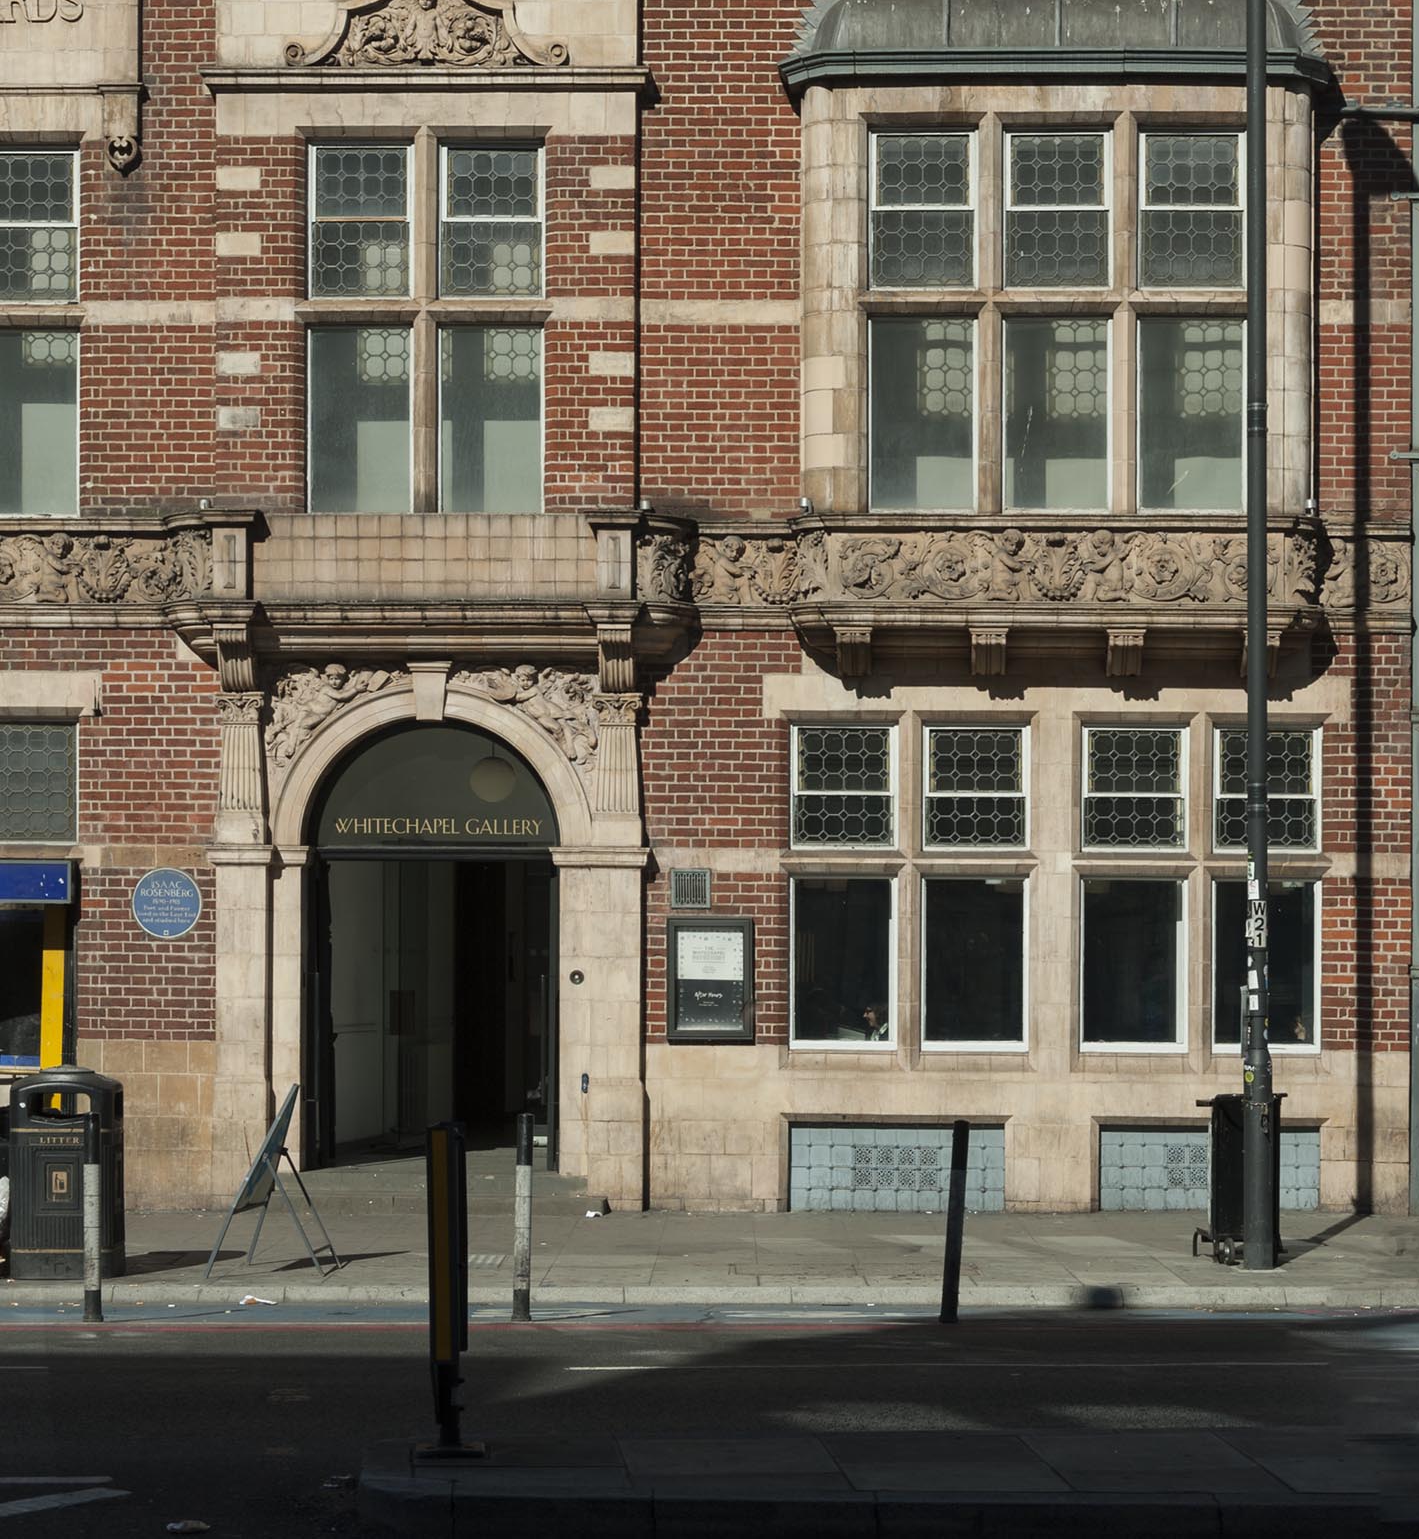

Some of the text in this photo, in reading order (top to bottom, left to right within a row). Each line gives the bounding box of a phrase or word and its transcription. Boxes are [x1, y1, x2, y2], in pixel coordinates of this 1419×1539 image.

[335, 817, 543, 836] WHITECHAPEL GALLERY
[140, 888, 194, 897] ROSENBERG
[40, 1136, 80, 1144] LITTER
